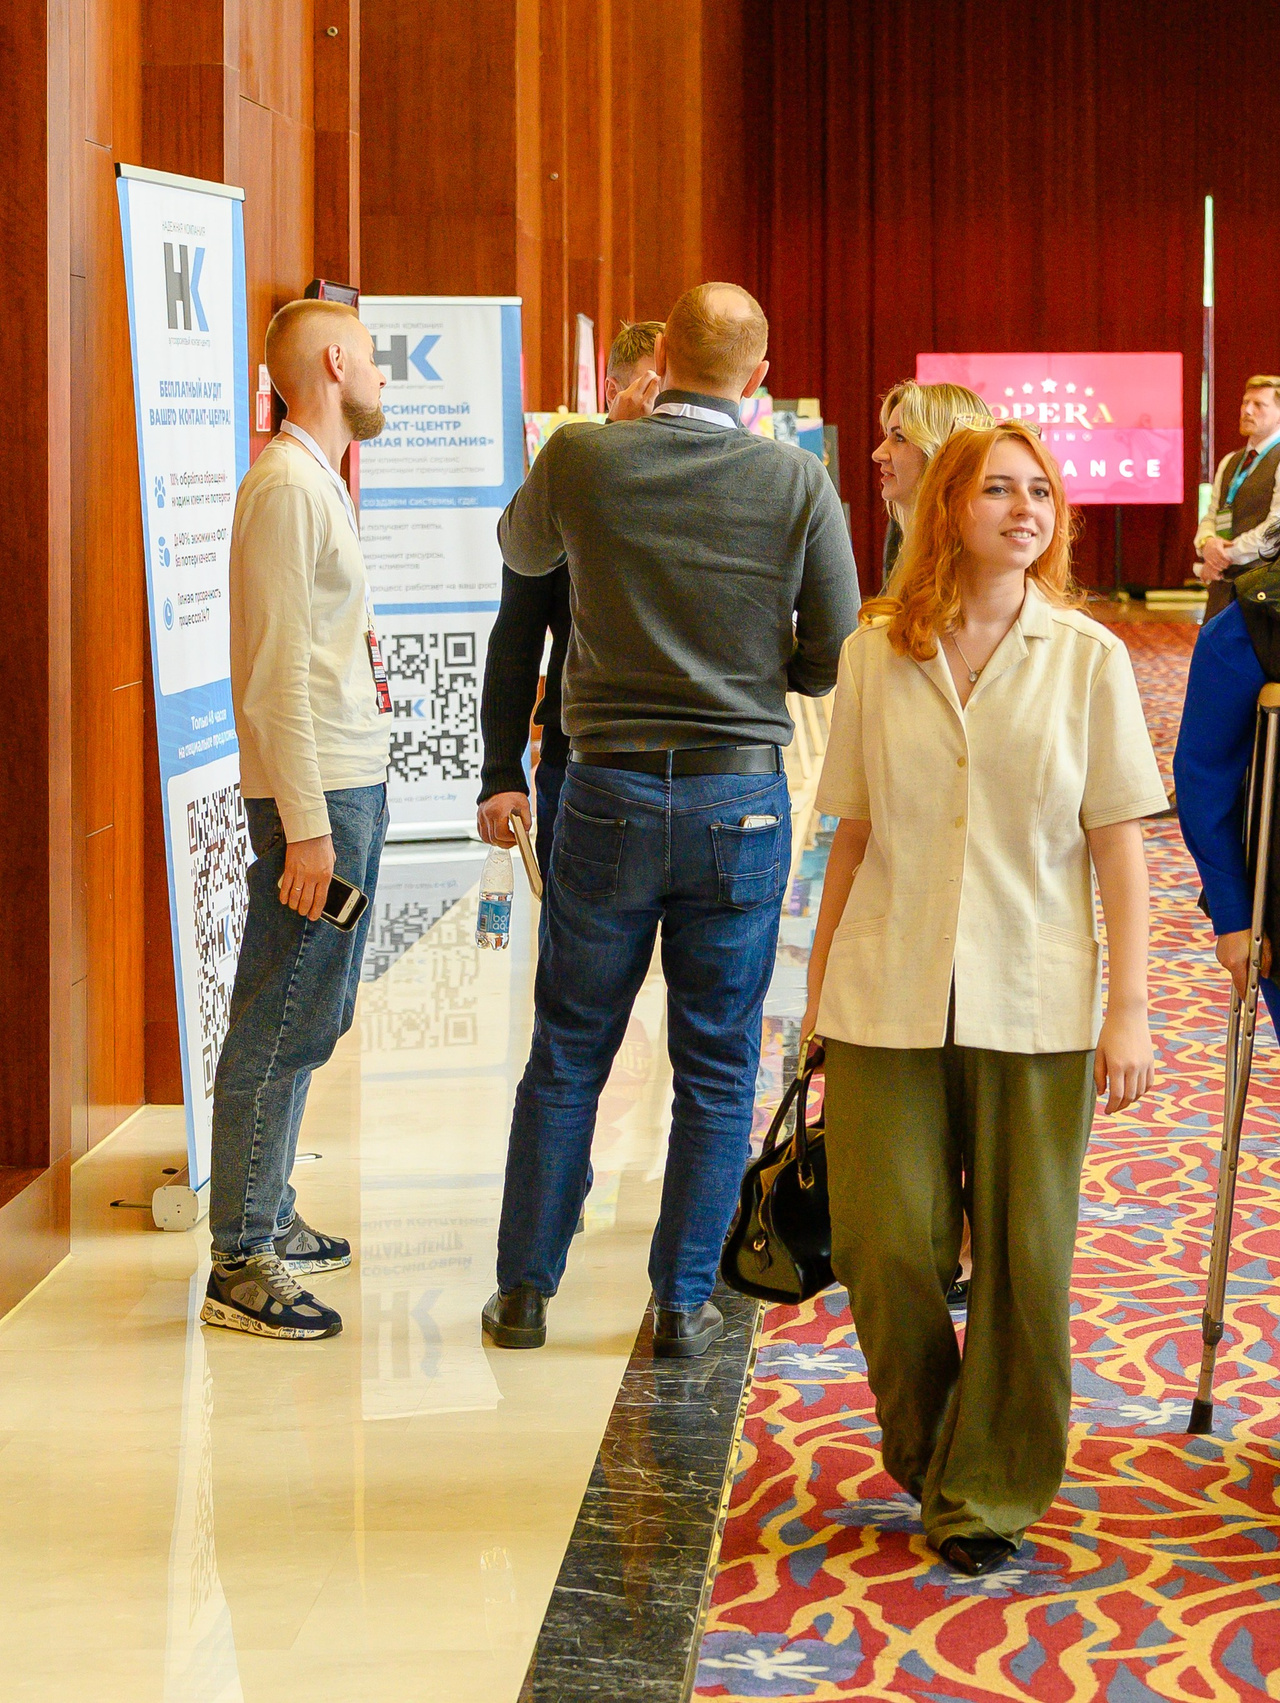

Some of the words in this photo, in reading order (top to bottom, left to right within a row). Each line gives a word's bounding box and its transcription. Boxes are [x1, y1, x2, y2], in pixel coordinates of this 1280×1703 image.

[160, 377, 202, 398] БЕСПЛАТНЫЙ
[149, 408, 177, 426] ВАШЕГО
[382, 402, 471, 415] РСИНГОВЫЙ
[988, 402, 1114, 430] OPERA
[384, 421, 462, 433] АКТ-ЦЕНТР
[360, 438, 402, 448] ЖНАЯ
[1062, 459, 1161, 478] ANCE
